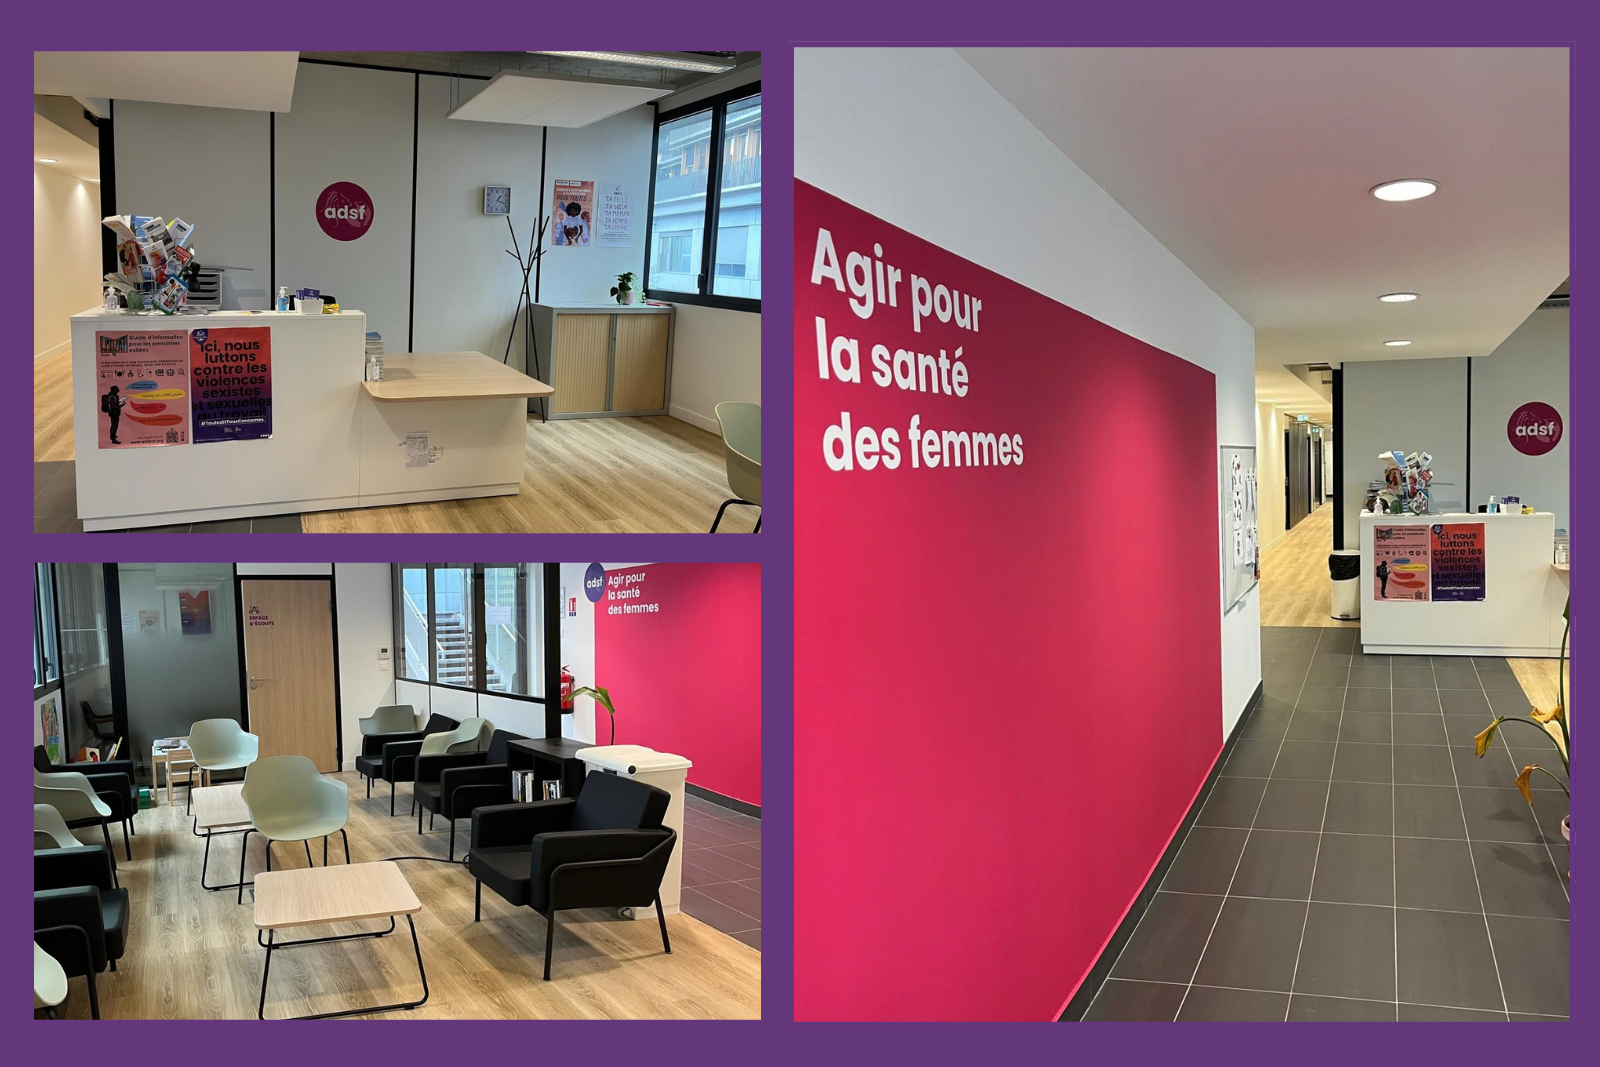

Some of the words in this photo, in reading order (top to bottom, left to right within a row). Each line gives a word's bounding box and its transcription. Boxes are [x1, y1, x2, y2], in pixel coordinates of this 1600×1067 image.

[324, 204, 366, 220] adsf
[811, 228, 902, 320] Agir
[910, 274, 982, 332] pour
[224, 341, 260, 351] nous
[205, 352, 256, 363] luttons
[816, 316, 861, 384] la
[871, 344, 969, 397] santé
[194, 364, 243, 376] contre
[247, 362, 267, 373] les
[196, 375, 266, 387] violences
[202, 386, 260, 398] sexistes
[192, 401, 204, 411] et
[207, 396, 272, 410] sexuelles
[197, 412, 216, 420] au
[220, 407, 266, 418] travail
[1515, 422, 1554, 436] adsf
[823, 412, 901, 472] des
[908, 414, 1024, 468] femmes
[587, 576, 603, 588] adsf
[608, 573, 624, 588] Agir
[626, 573, 645, 586] pour
[608, 590, 615, 600] la
[617, 586, 640, 599] santé
[608, 604, 622, 615] des
[624, 603, 659, 614] femmes
